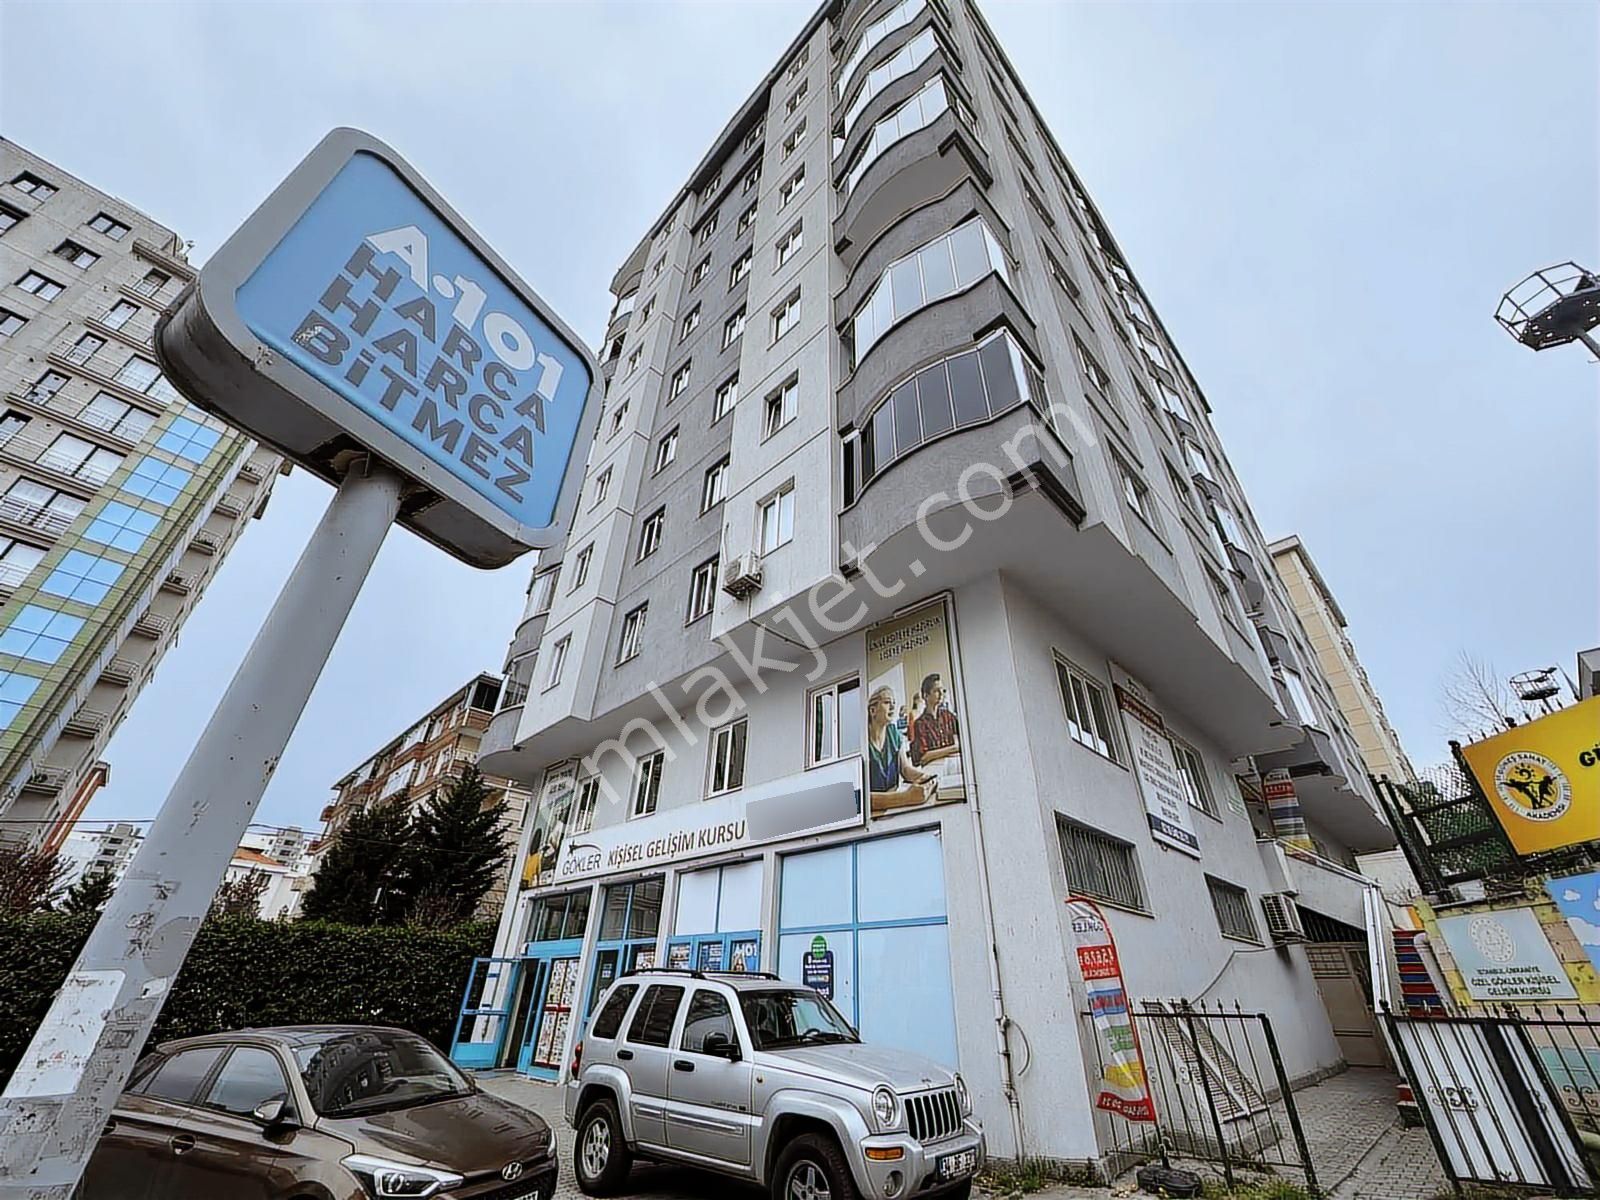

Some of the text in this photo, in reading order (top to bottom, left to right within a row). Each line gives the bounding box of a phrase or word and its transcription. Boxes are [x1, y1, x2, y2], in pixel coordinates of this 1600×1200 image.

[320, 275, 534, 468] HARCA
[344, 242, 546, 434] HARCA
[607, 819, 746, 869] KİŞİSEL GELİŞİM KURSU
